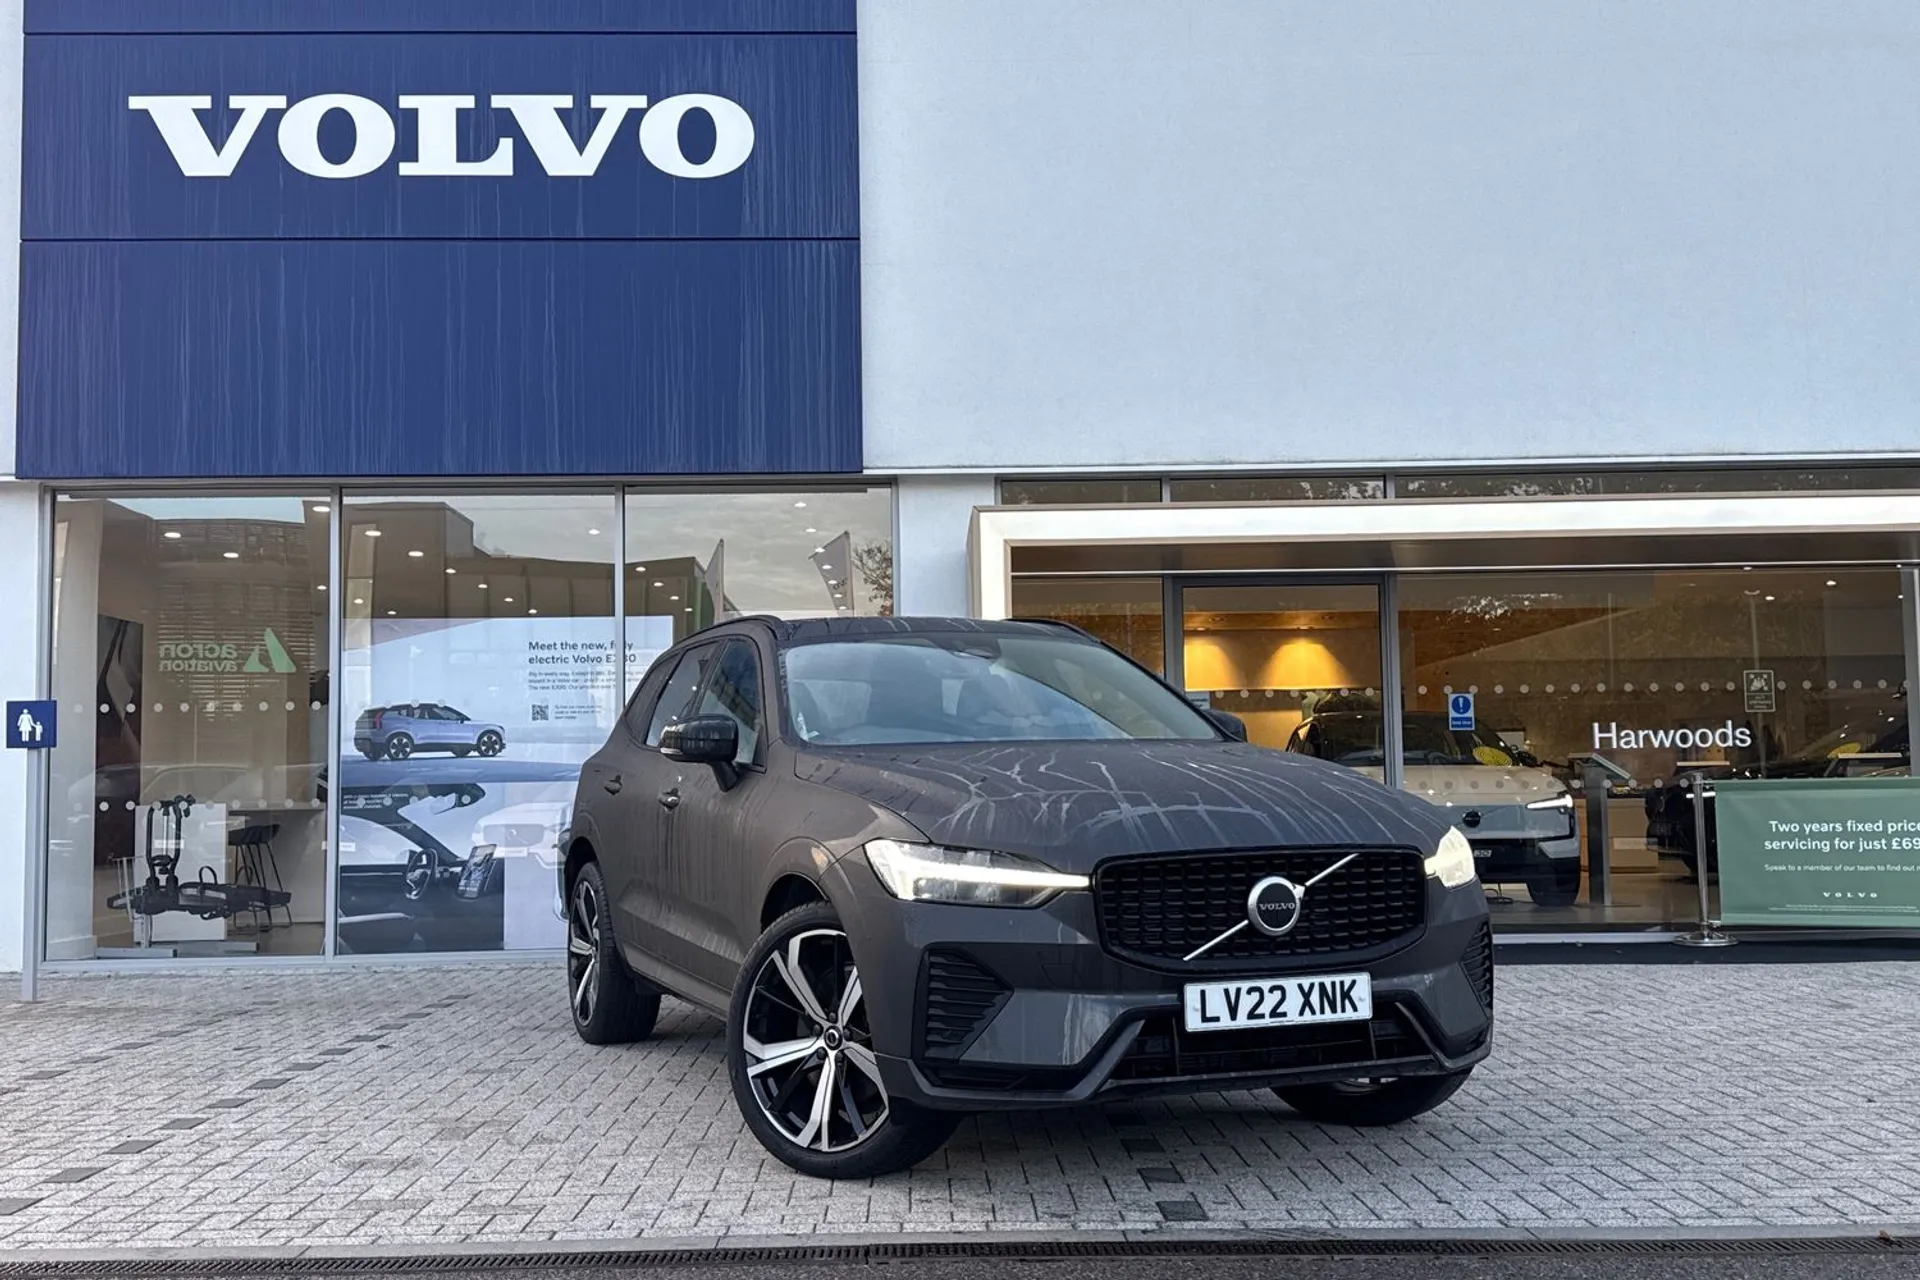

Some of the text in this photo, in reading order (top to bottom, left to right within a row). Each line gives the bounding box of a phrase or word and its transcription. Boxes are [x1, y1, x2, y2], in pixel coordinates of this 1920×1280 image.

[128, 93, 755, 179] VOLVO
[528, 641, 557, 651] Meet
[560, 640, 578, 651] the
[581, 642, 607, 651] new,
[528, 655, 569, 664] electric
[572, 655, 603, 664] Volvo
[1592, 720, 1752, 749] Harwoods
[1769, 821, 1800, 832] Two
[1803, 822, 1843, 835] years
[1847, 820, 1883, 832] fixed
[1764, 838, 1831, 852] servicing
[1834, 838, 1855, 850] for
[1858, 838, 1887, 852] just
[1258, 902, 1296, 910] VOLVO
[1200, 979, 1358, 1024] LV22 XNK
